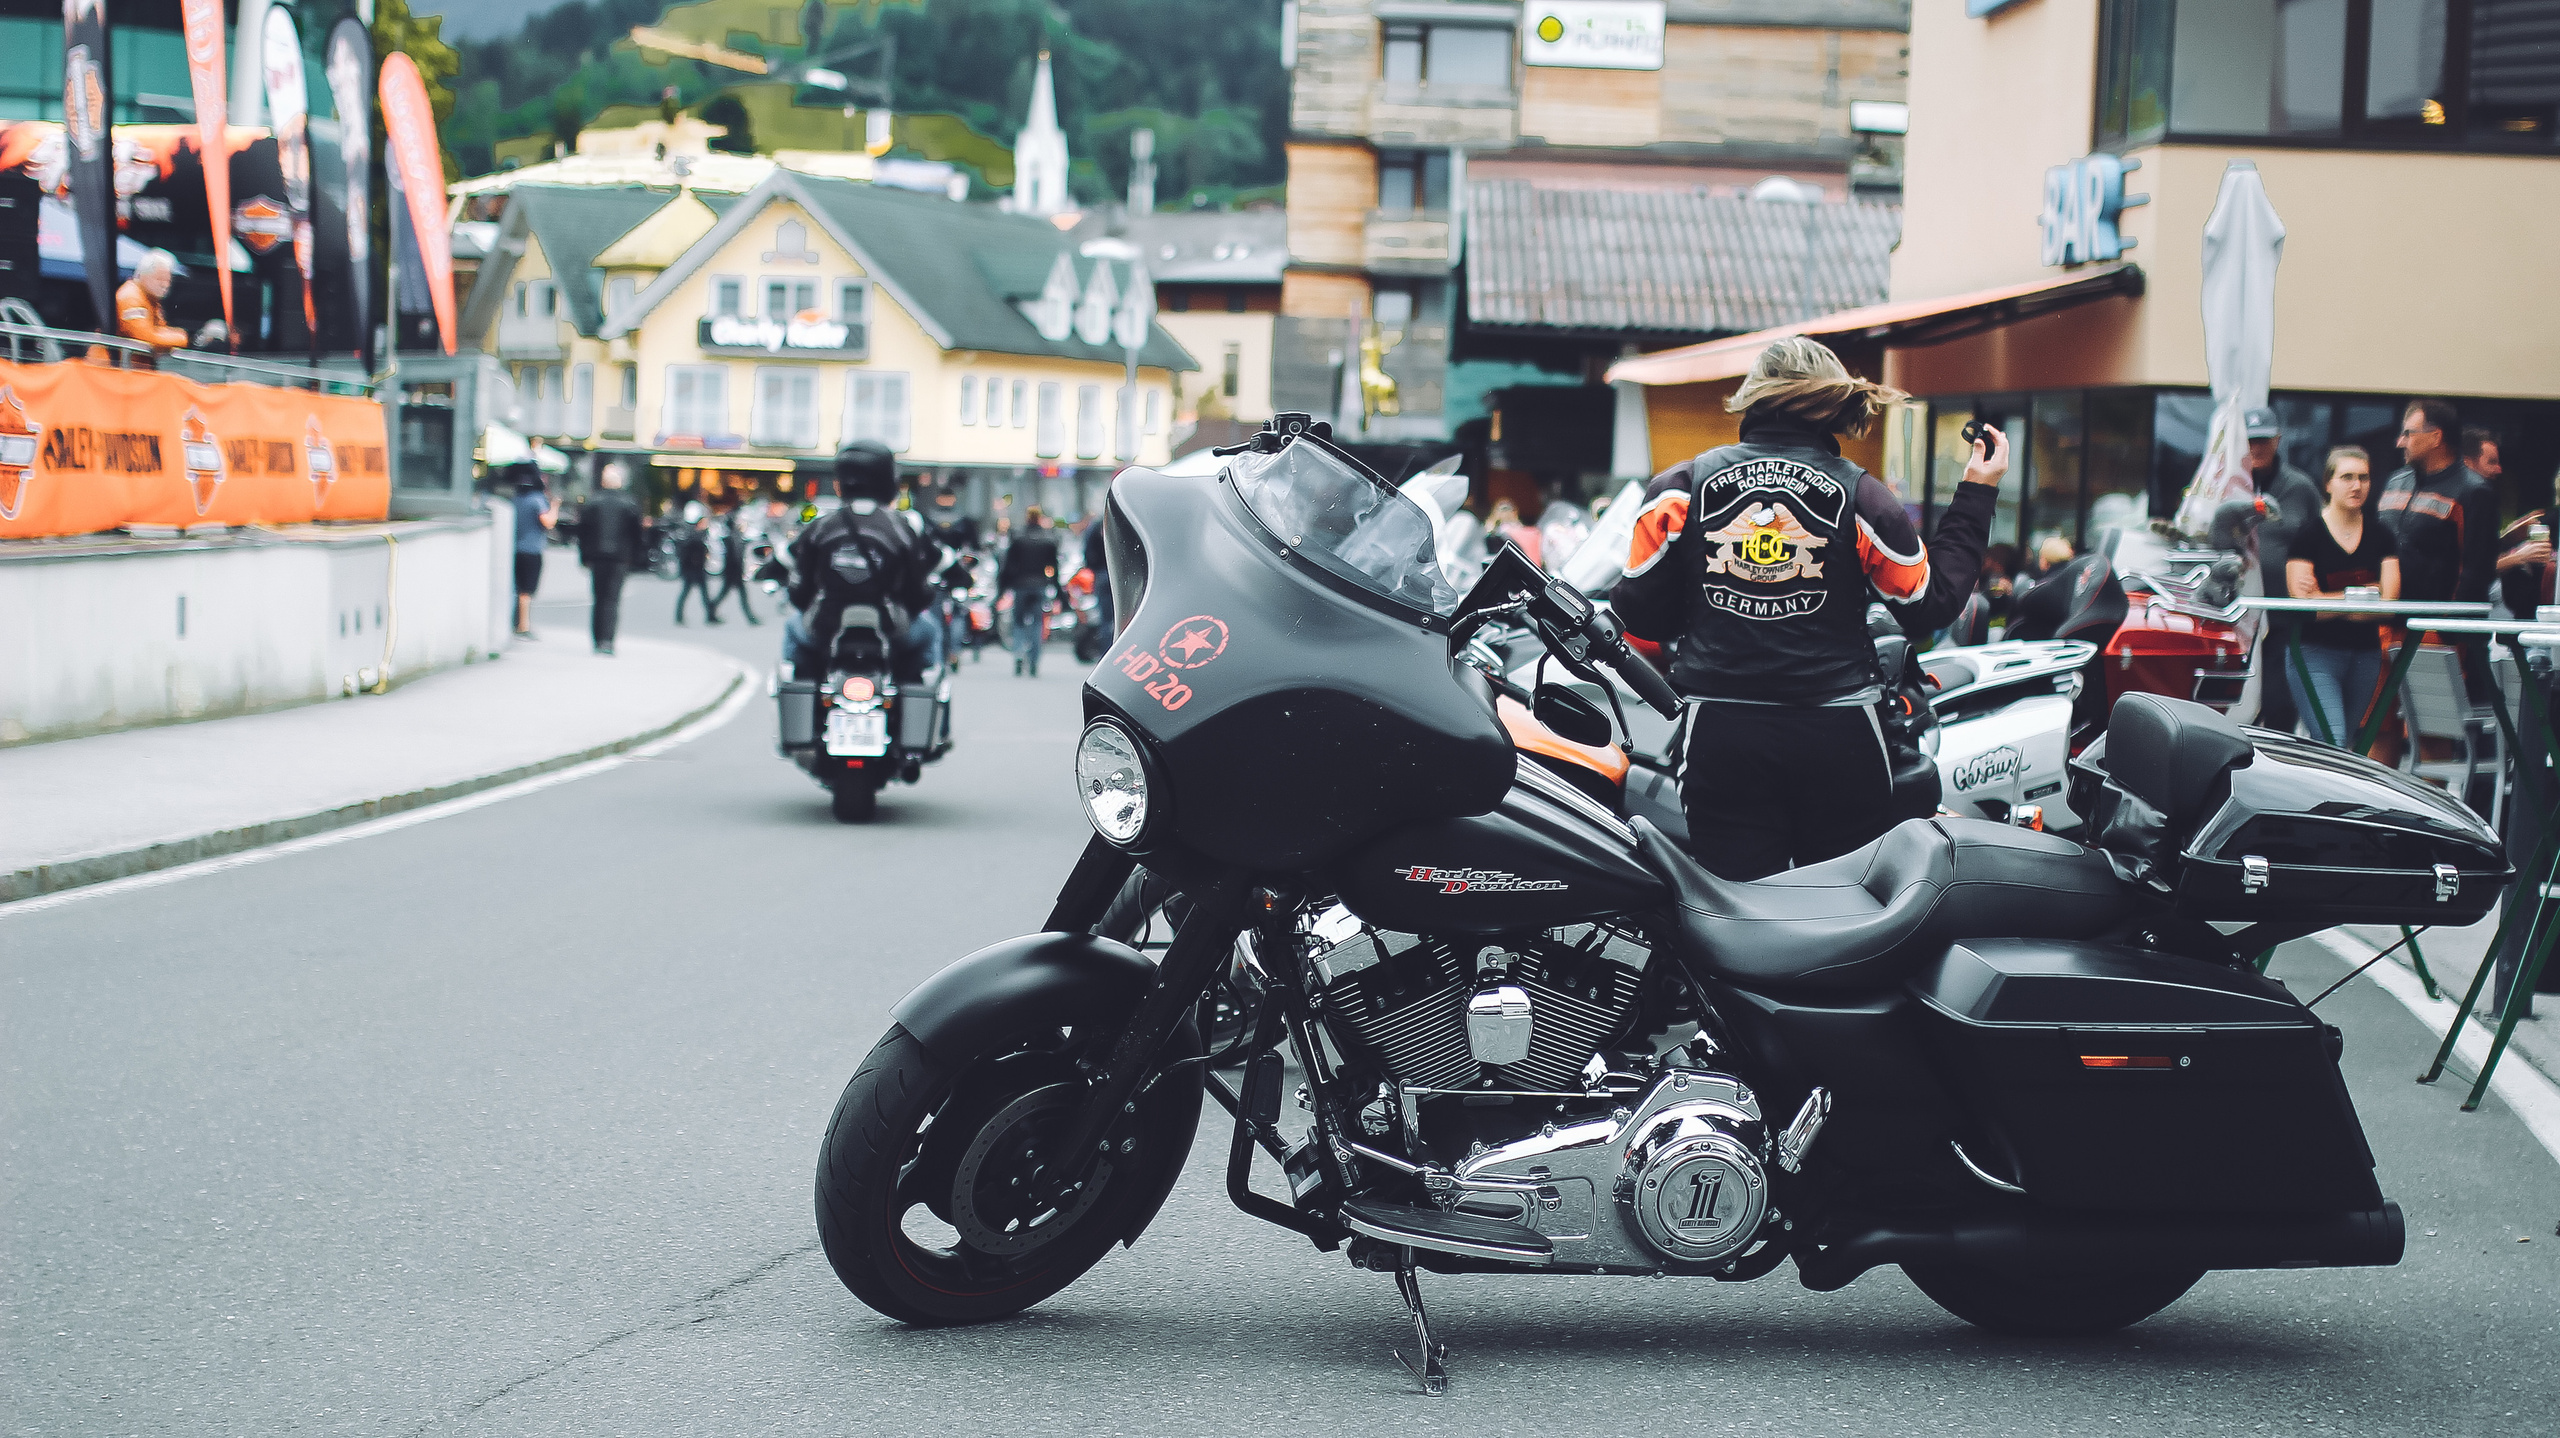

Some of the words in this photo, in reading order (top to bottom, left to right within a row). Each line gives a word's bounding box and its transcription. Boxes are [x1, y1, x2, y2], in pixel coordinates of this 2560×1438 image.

[2041, 157, 2107, 266] BAR
[1710, 468, 1744, 493] FREE
[1746, 462, 1803, 479] HARLEY
[1801, 469, 1838, 498] RIDER
[1737, 473, 1810, 496] ROSENHEIM
[1735, 558, 1762, 574] HARLEY
[1762, 562, 1794, 574] OWNERS
[1750, 572, 1777, 582] GROUP
[1713, 591, 1812, 615] GERMANY
[1396, 866, 1513, 883] Harley
[1440, 877, 1568, 894] Davidson
